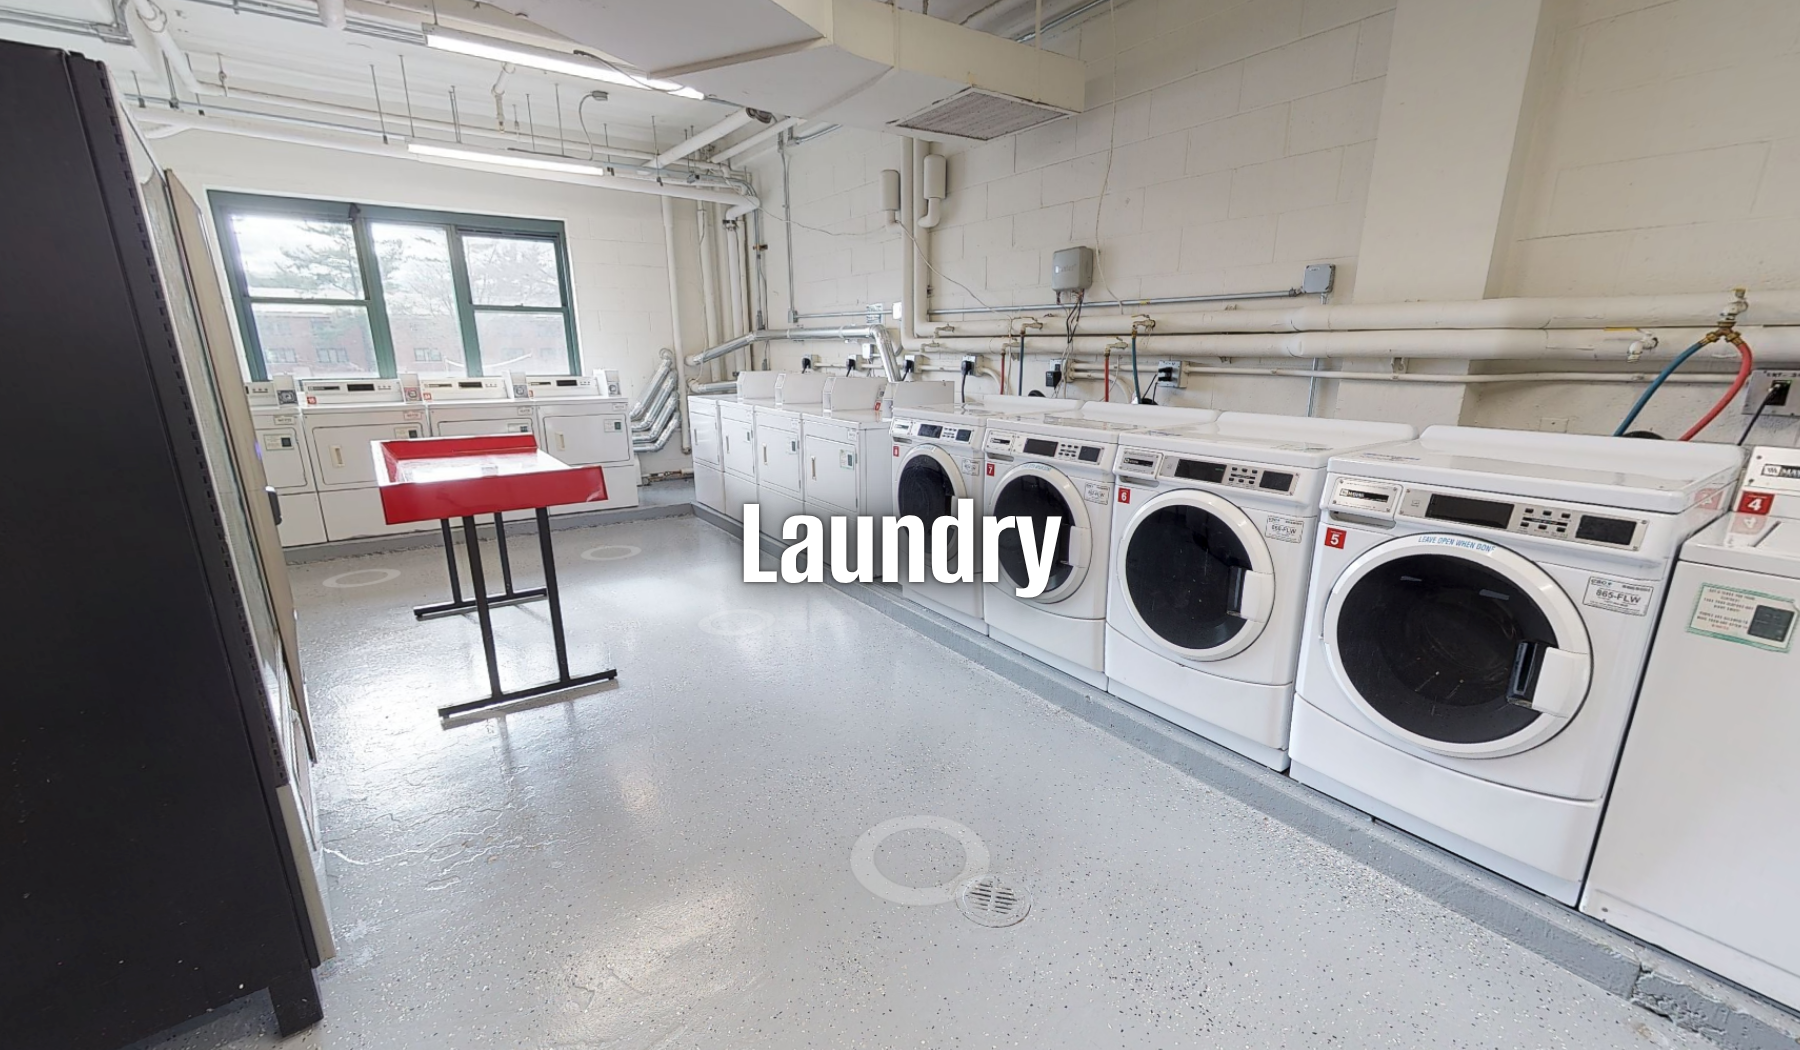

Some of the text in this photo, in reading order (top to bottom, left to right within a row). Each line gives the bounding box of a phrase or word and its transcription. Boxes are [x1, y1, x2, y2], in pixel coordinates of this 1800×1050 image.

[1781, 467, 1800, 478] MA
[1120, 491, 1127, 501] 6
[1747, 498, 1763, 511] 4
[1330, 533, 1340, 546] 5
[1418, 535, 1437, 544] LEAVE
[1437, 536, 1455, 546] OPEN
[1455, 539, 1476, 549] WHEN
[1595, 589, 1641, 604] 865-FLW
